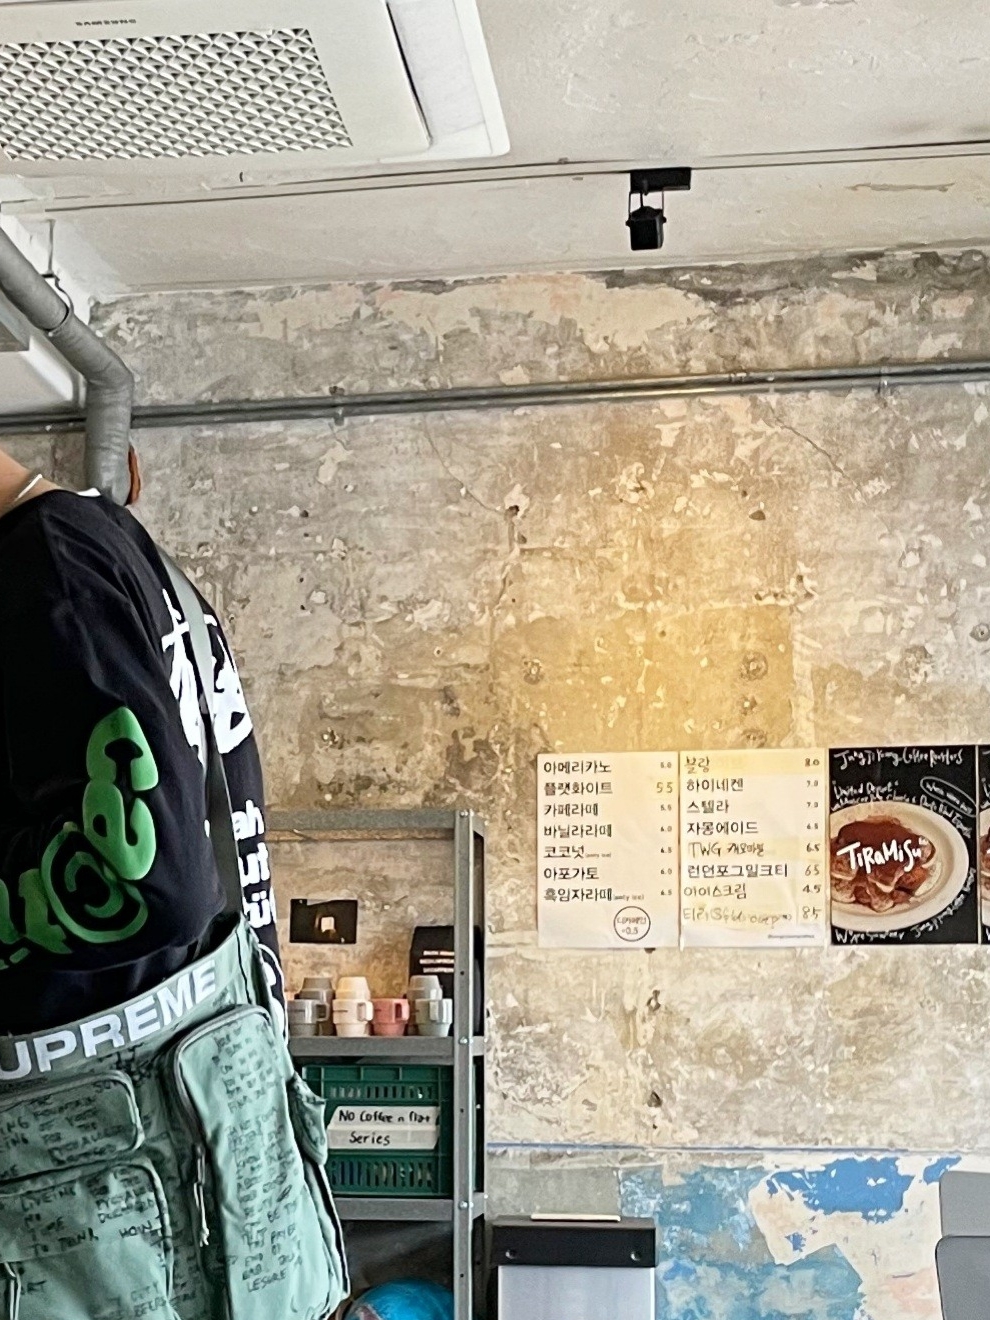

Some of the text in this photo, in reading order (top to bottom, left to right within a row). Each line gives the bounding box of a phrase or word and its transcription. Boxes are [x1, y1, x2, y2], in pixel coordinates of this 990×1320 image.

[543, 760, 612, 774] 아메리카노
[544, 781, 613, 796] 플랫화이트
[686, 778, 743, 792] 하이네켄
[543, 803, 599, 817] 카페라떼
[686, 799, 729, 814] 스텔라
[543, 824, 612, 838] 바닐라라떼
[686, 821, 759, 835] 자몽에이드
[543, 844, 585, 859] 코코넛
[543, 867, 600, 880] 아포가토
[543, 887, 613, 902] 흑임자라떼
[349, 1130, 391, 1146] Series
